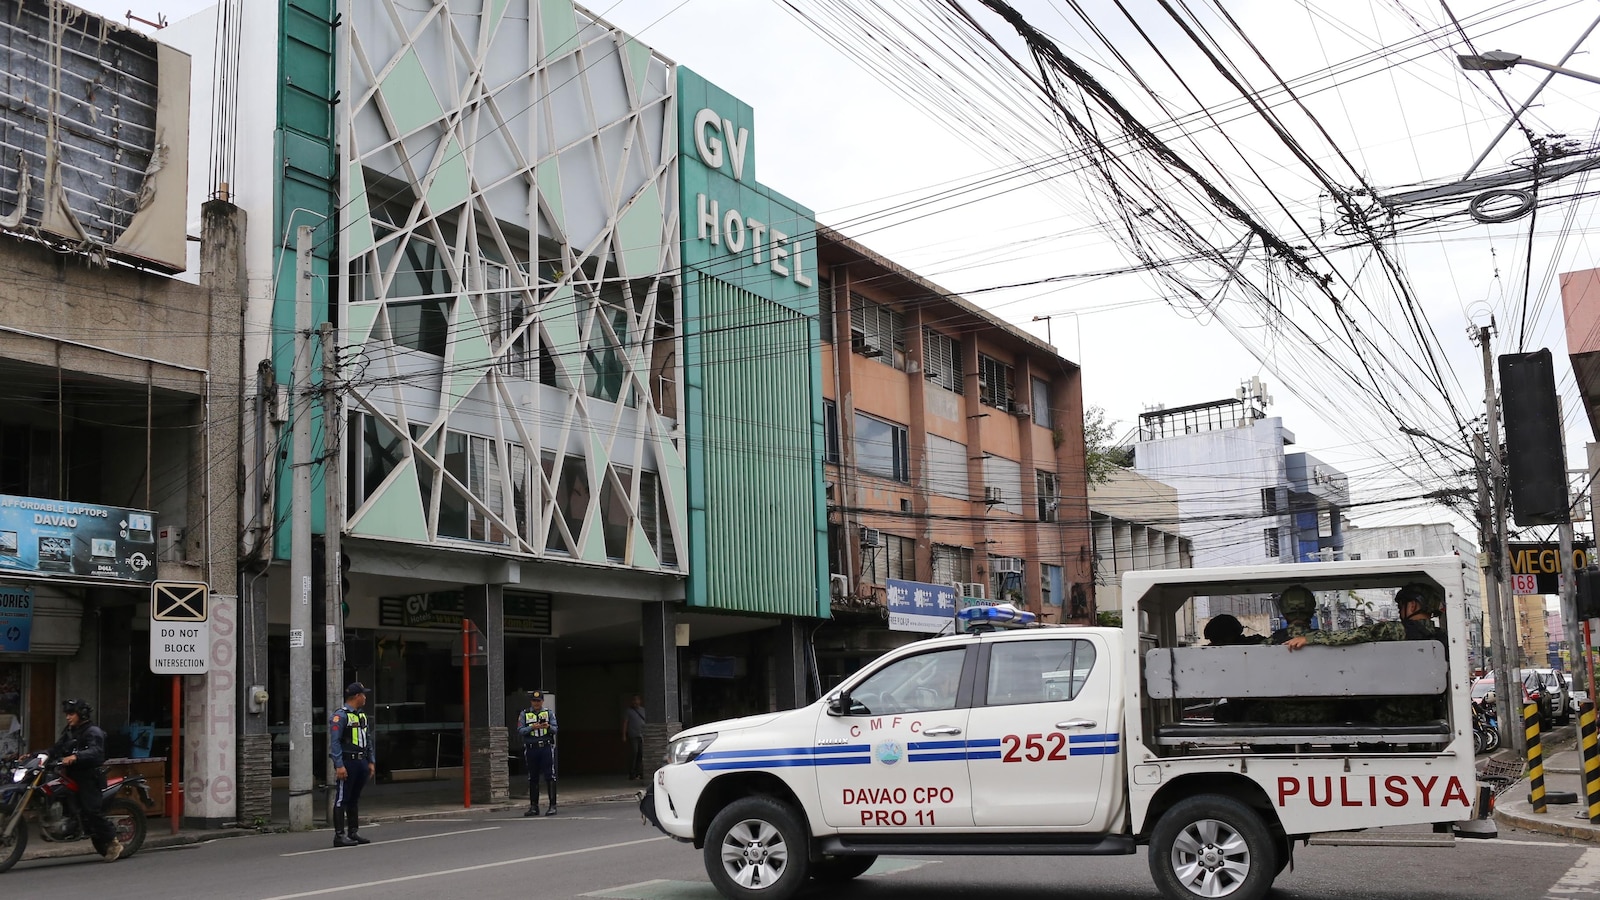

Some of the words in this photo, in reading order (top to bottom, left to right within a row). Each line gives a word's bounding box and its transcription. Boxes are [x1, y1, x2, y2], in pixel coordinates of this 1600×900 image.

[694, 108, 749, 181] GV
[697, 193, 812, 288] HOTEL
[1, 501, 64, 512] AFFORDABLE
[66, 505, 108, 518] LAPTOPS
[34, 513, 78, 528] DAVAO
[406, 593, 429, 615] GV
[161, 629, 175, 638] DO
[179, 629, 199, 638] NOT
[164, 644, 196, 652] BLOCK
[155, 659, 205, 668] INTERSECTION
[1002, 732, 1067, 763] 252
[842, 787, 907, 805] DAVAO
[913, 787, 954, 804] CPO
[1277, 775, 1470, 807] PULISYA
[860, 810, 907, 826] PRO
[914, 810, 935, 826] 11
